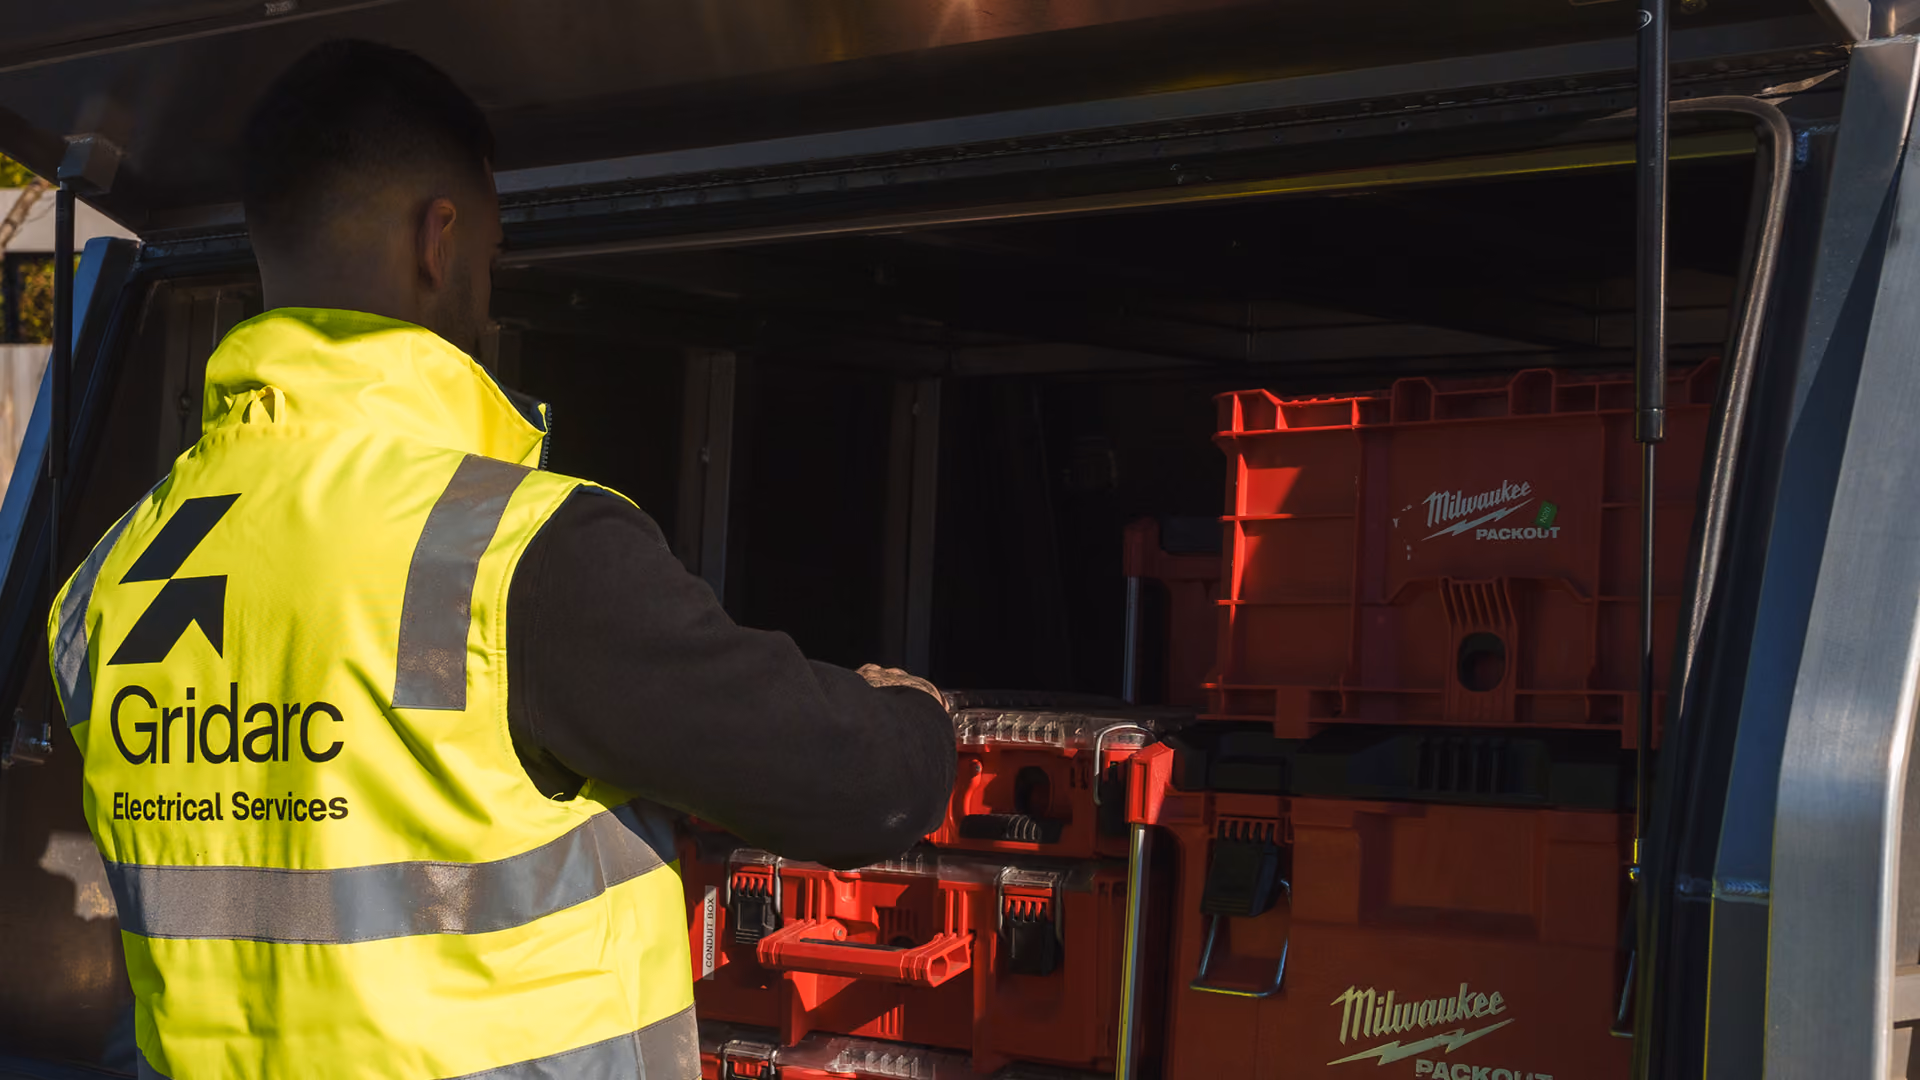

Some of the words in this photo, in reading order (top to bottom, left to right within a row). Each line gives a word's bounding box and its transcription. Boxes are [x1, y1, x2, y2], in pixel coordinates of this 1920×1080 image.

[1421, 480, 1532, 528] Milwaukee
[1476, 527, 1560, 540] PACKOUT
[110, 682, 344, 765] Gridarc
[113, 792, 223, 821] Electrical
[232, 791, 348, 822] Services
[705, 923, 714, 968] CONDUIT
[1330, 983, 1507, 1047] Milwaukee
